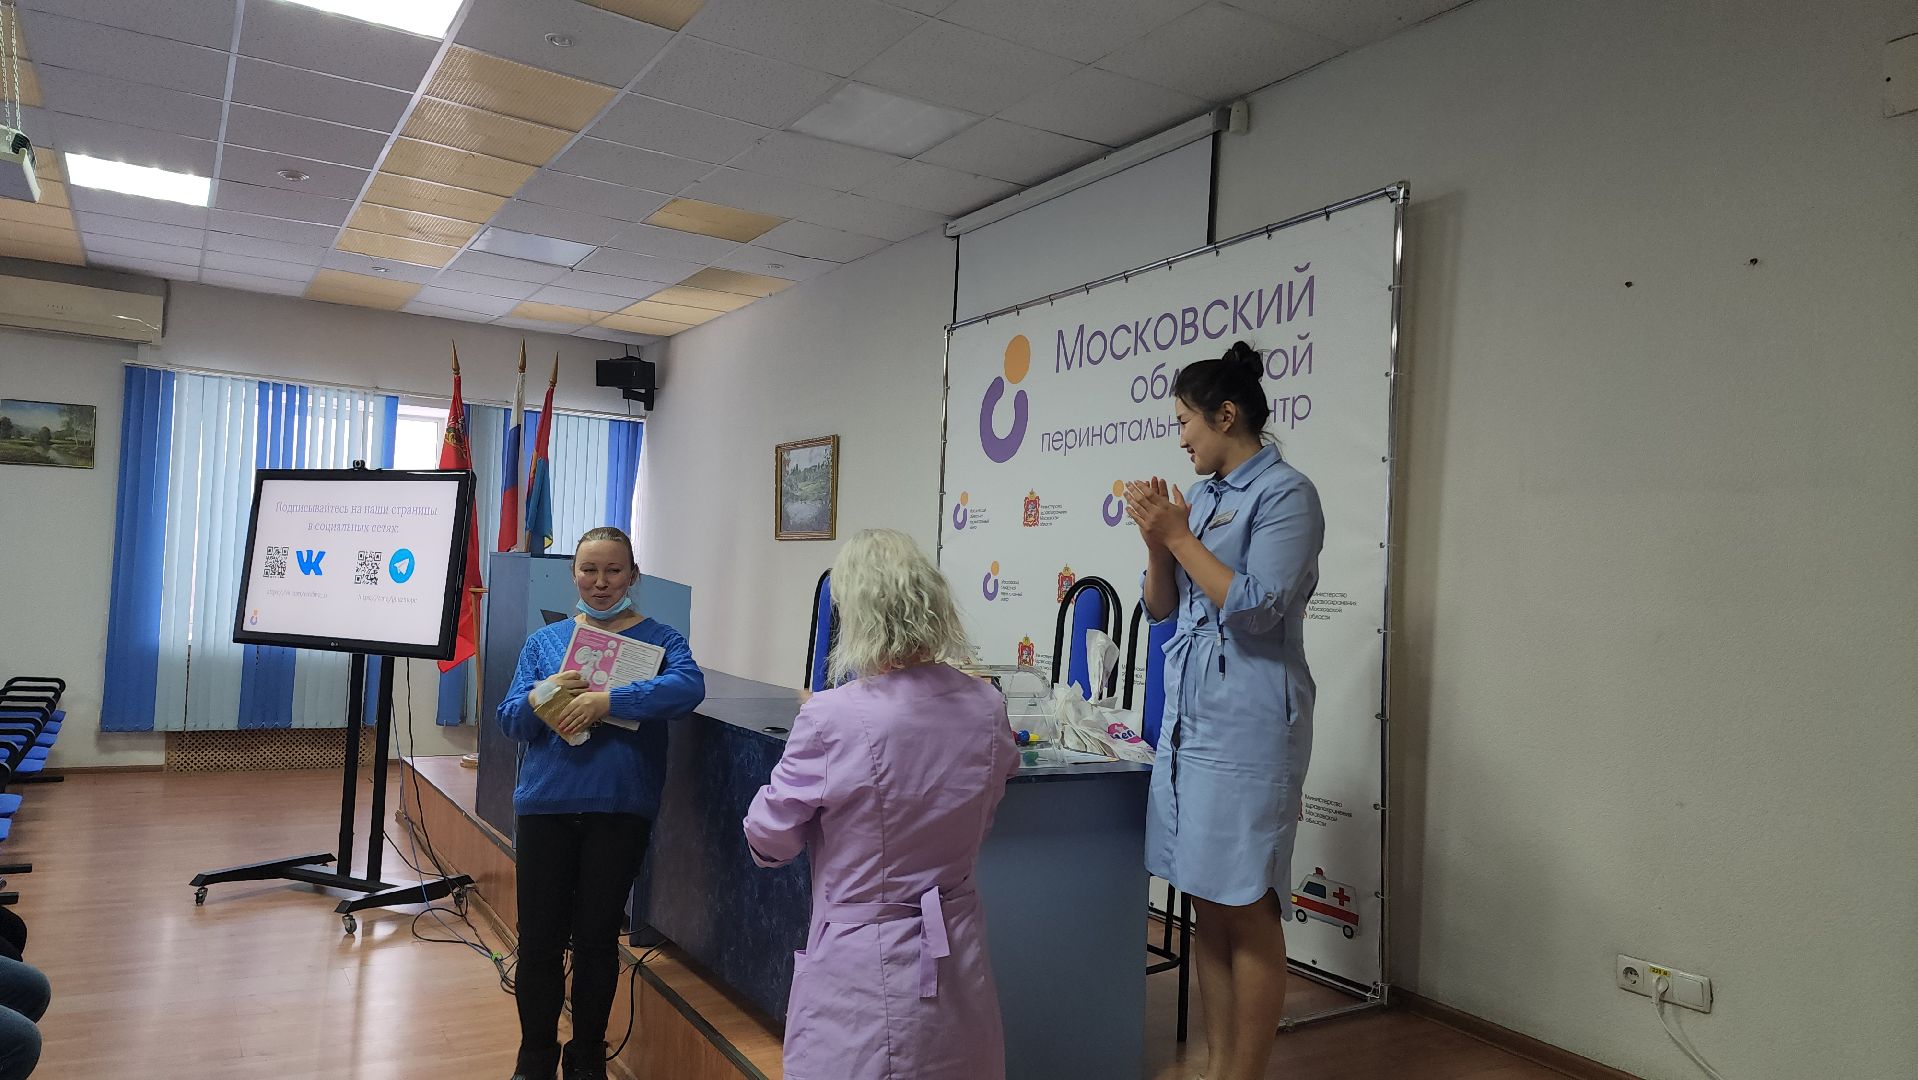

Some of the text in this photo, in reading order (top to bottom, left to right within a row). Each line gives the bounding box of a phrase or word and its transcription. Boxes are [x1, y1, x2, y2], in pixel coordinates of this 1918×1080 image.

[1055, 261, 1315, 374] Московский
[1041, 415, 1181, 456] перинатальн
[275, 501, 438, 517] Подписывайтесь на наши страницы
